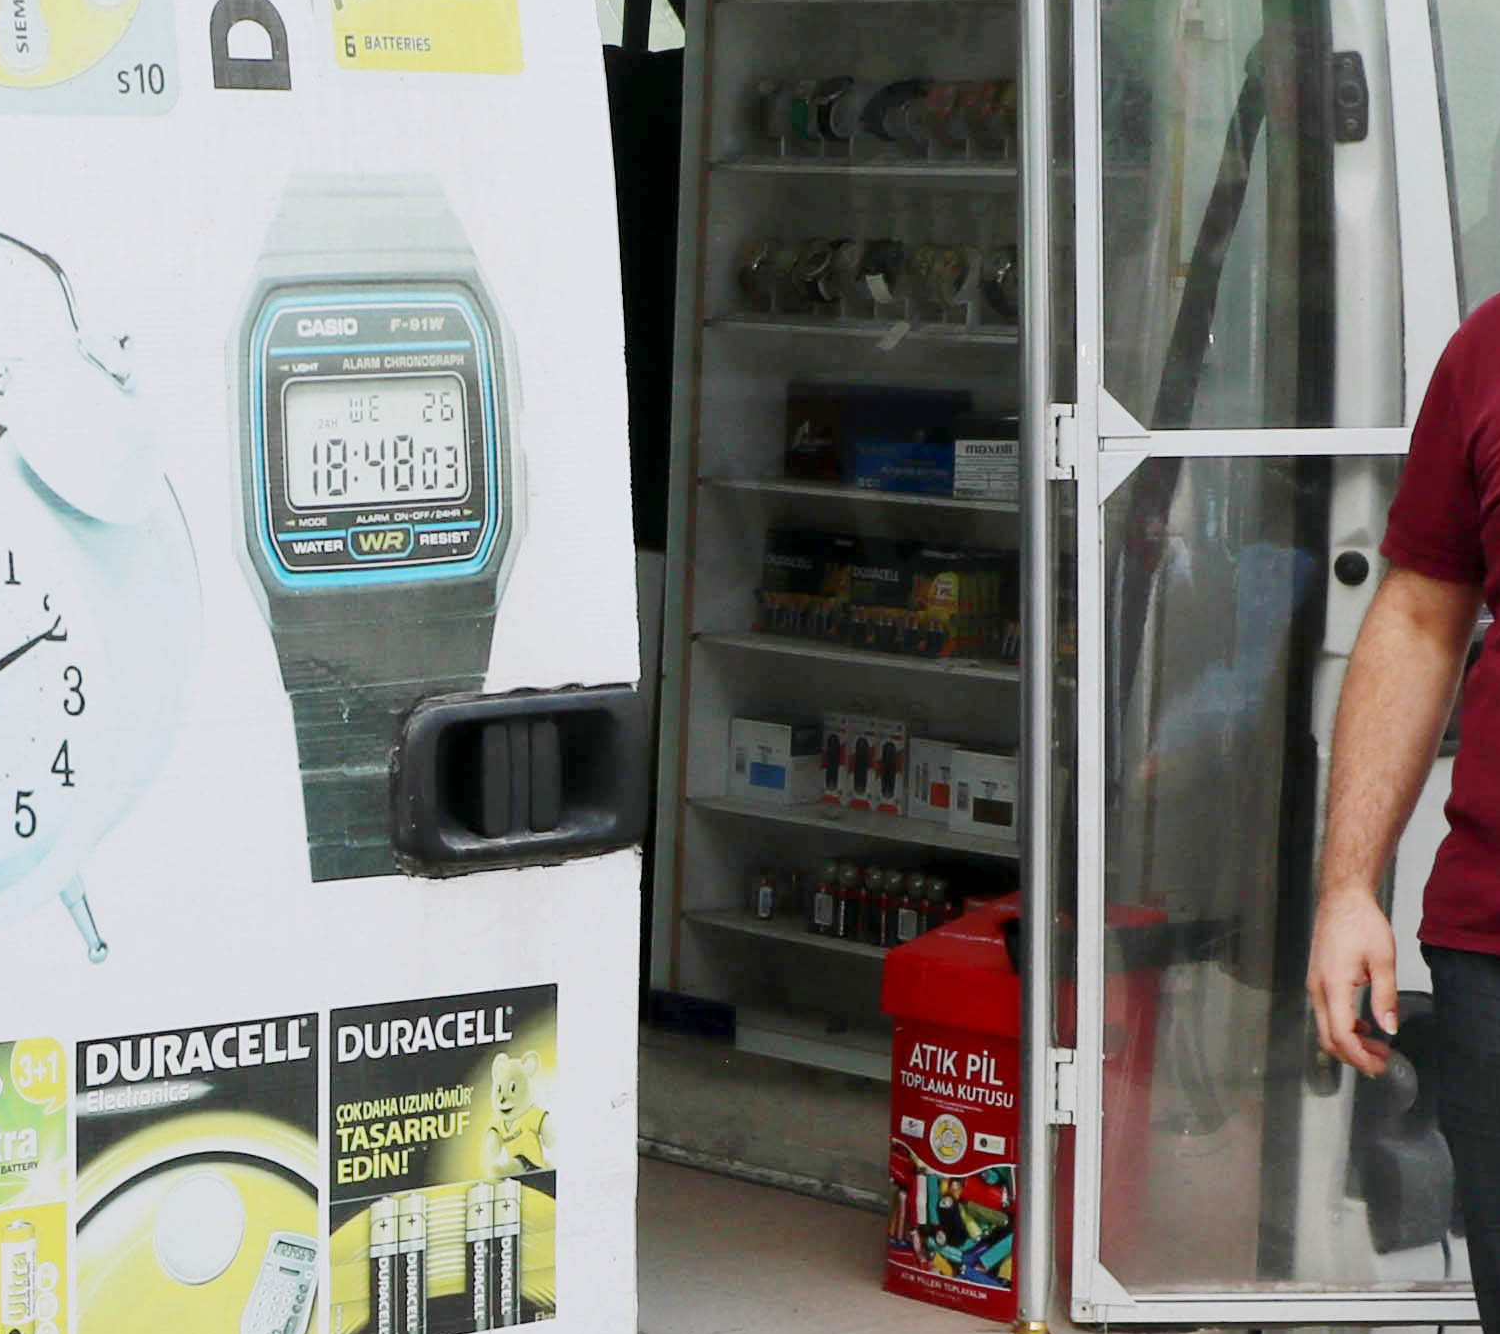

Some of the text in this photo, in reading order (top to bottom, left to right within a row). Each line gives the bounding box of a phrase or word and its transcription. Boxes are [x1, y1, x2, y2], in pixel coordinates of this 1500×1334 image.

[364, 35, 432, 52] BATTERIES
[297, 317, 445, 338] CASIO F-91W
[342, 354, 464, 372] ALARM CHRONOGRAPH
[292, 530, 470, 555] WATER WR RESIST
[64, 666, 85, 715] 3
[51, 739, 75, 787] 4
[15, 790, 36, 838] 5
[86, 1018, 311, 1087] DURACELL
[337, 1007, 513, 1063] DURACELL
[19, 1051, 59, 1088] 3+1
[909, 1043, 1003, 1086] ATIK PİL
[86, 1082, 189, 1113] Electronics
[336, 1092, 434, 1128] ÇOK DAHA UZUN
[901, 1070, 954, 1097] TOPLAMA
[957, 1084, 1014, 1108] KUTUSU
[336, 1111, 470, 1153] TASARRUF
[1, 1161, 39, 1175] BATTERY
[337, 1148, 410, 1184] EDİN!
[8, 1252, 28, 1321] Ultra
[406, 1254, 419, 1332] DURACELL
[473, 1243, 486, 1322] DURACELL
[500, 1239, 513, 1317] DURACELL
